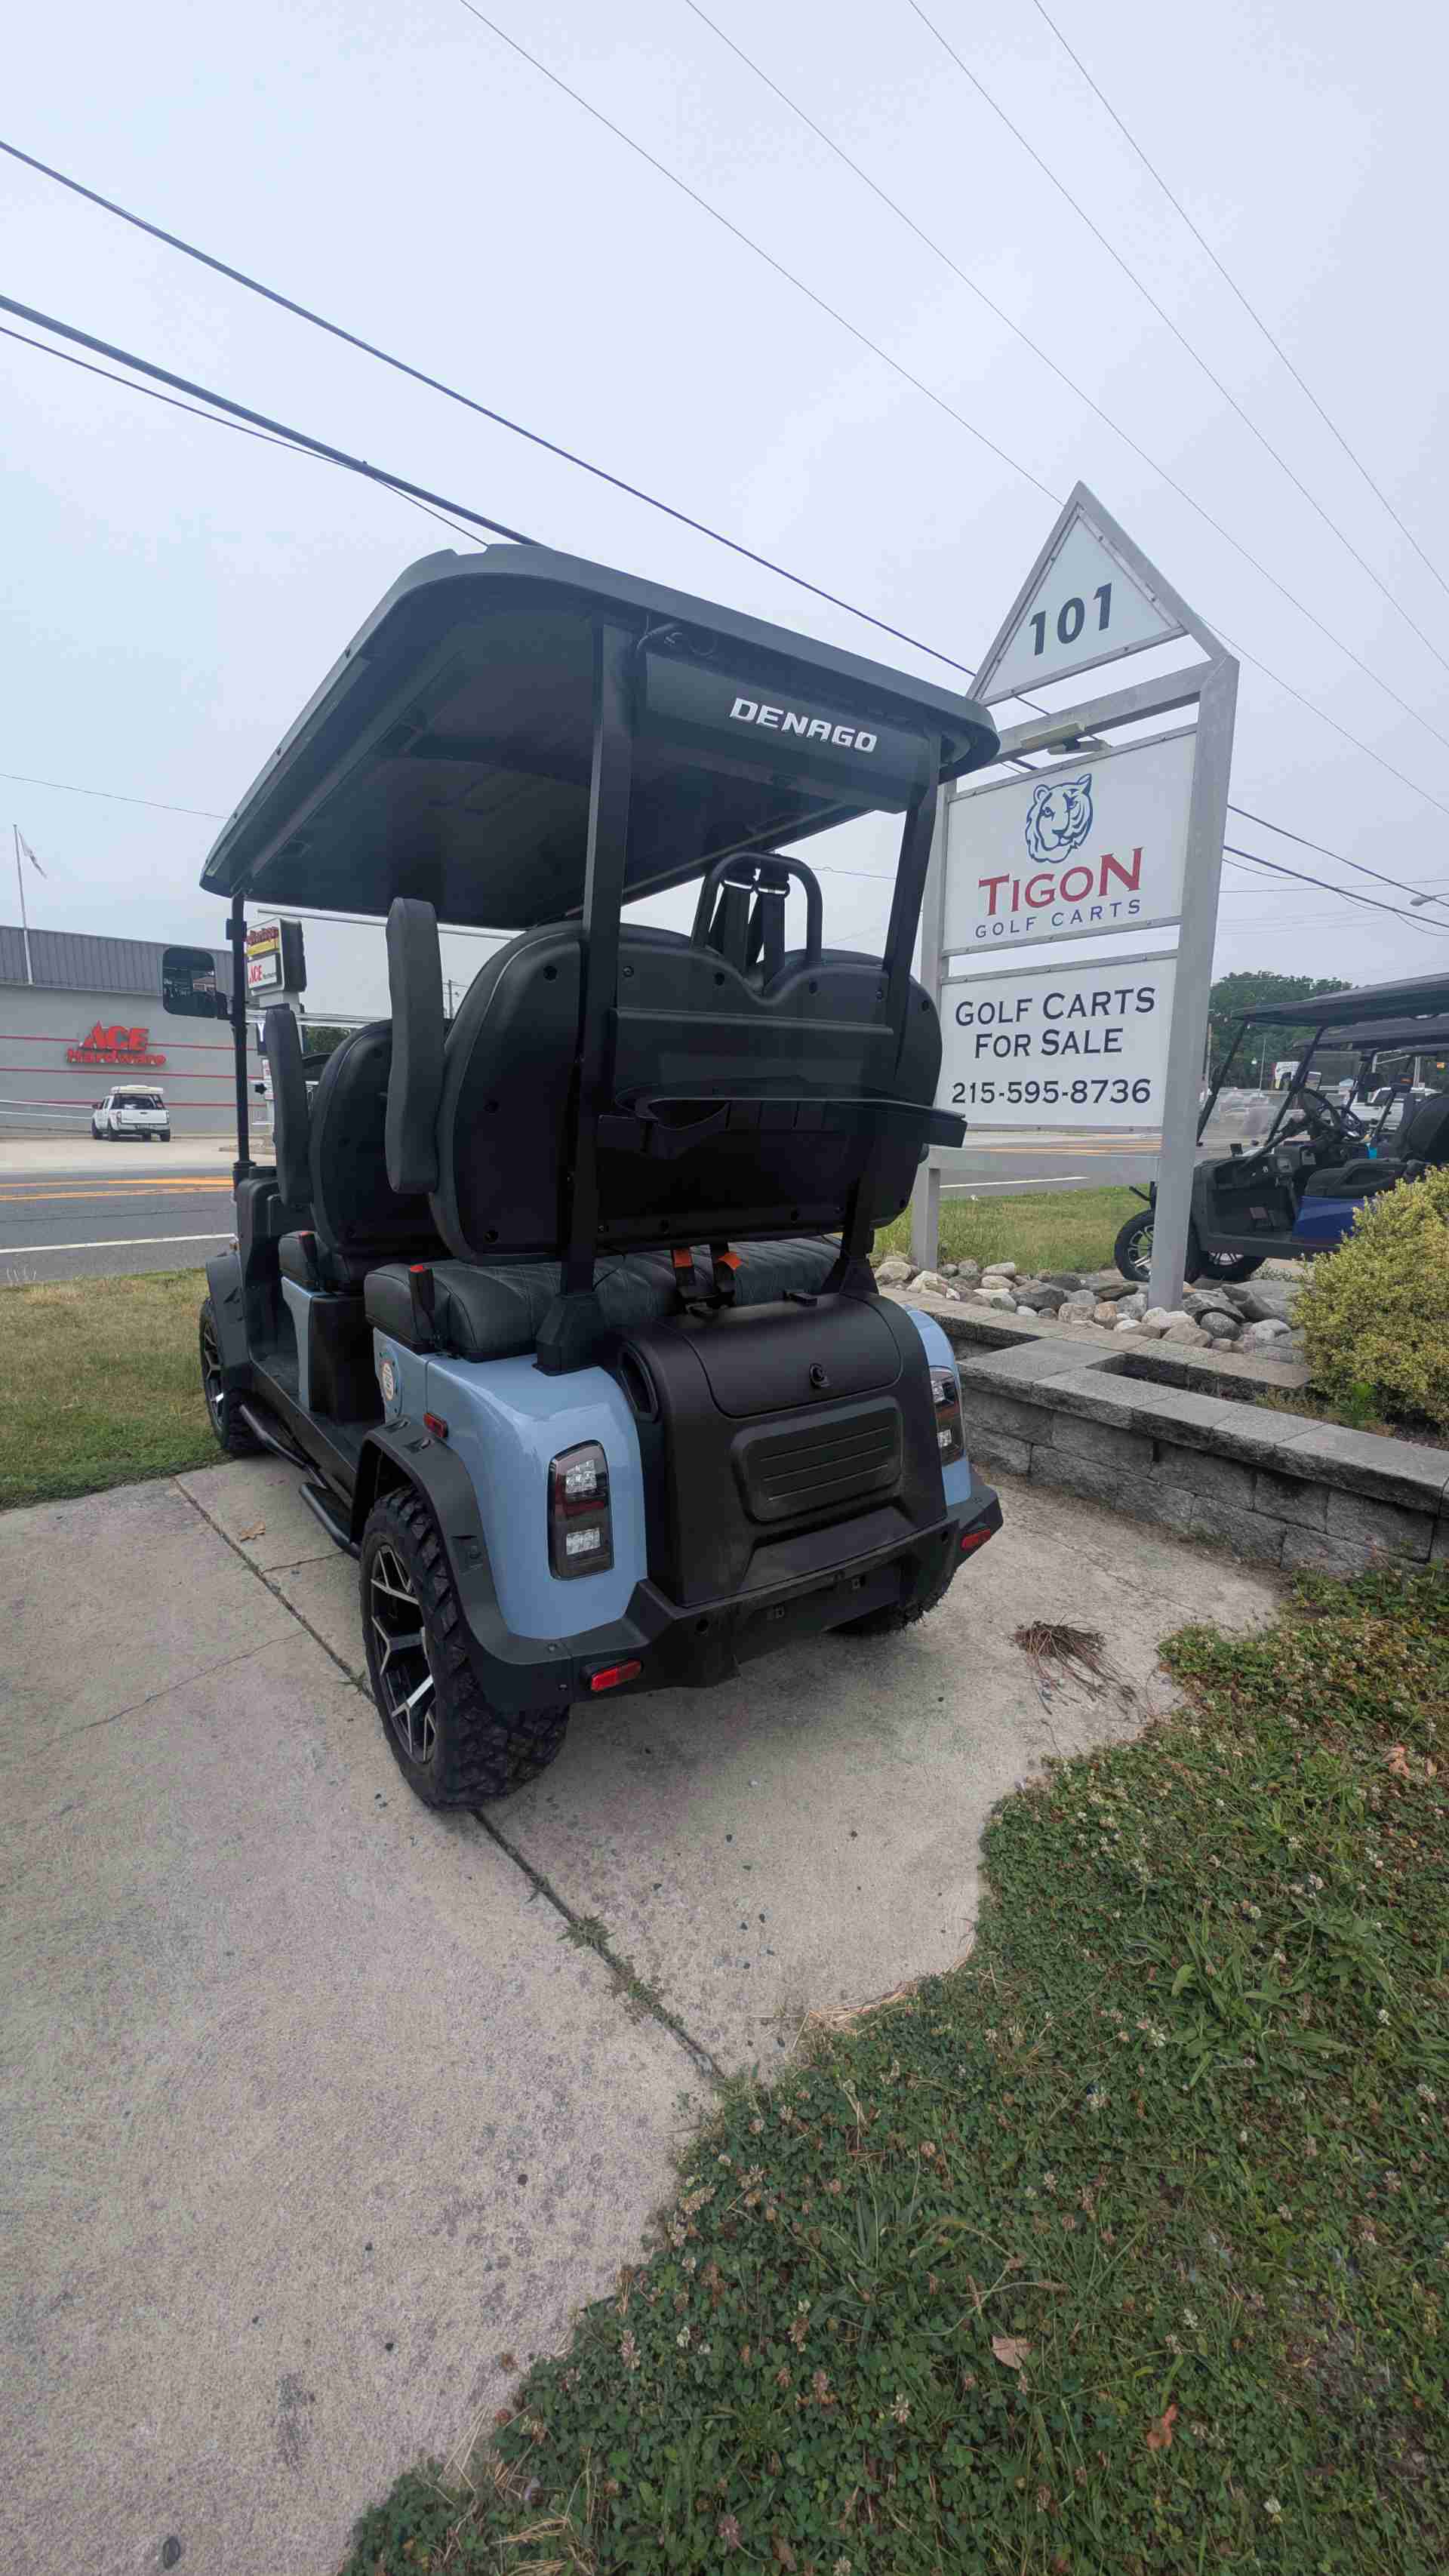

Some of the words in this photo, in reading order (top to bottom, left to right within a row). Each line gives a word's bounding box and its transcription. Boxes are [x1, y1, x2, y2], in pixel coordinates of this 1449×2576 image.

[1029, 583, 1112, 656] 101
[729, 697, 878, 753] DENAGO
[978, 847, 1143, 916] TIGON
[975, 916, 1038, 939] GOLF
[1051, 899, 1142, 927] CARTS
[955, 998, 1033, 1026] GOLF
[1042, 986, 1156, 1020] CARTS
[79, 1020, 149, 1051] ACE
[974, 1033, 1032, 1058] FOR
[1041, 1027, 1124, 1056] SALE
[952, 1079, 1152, 1104] 215-595-8736
